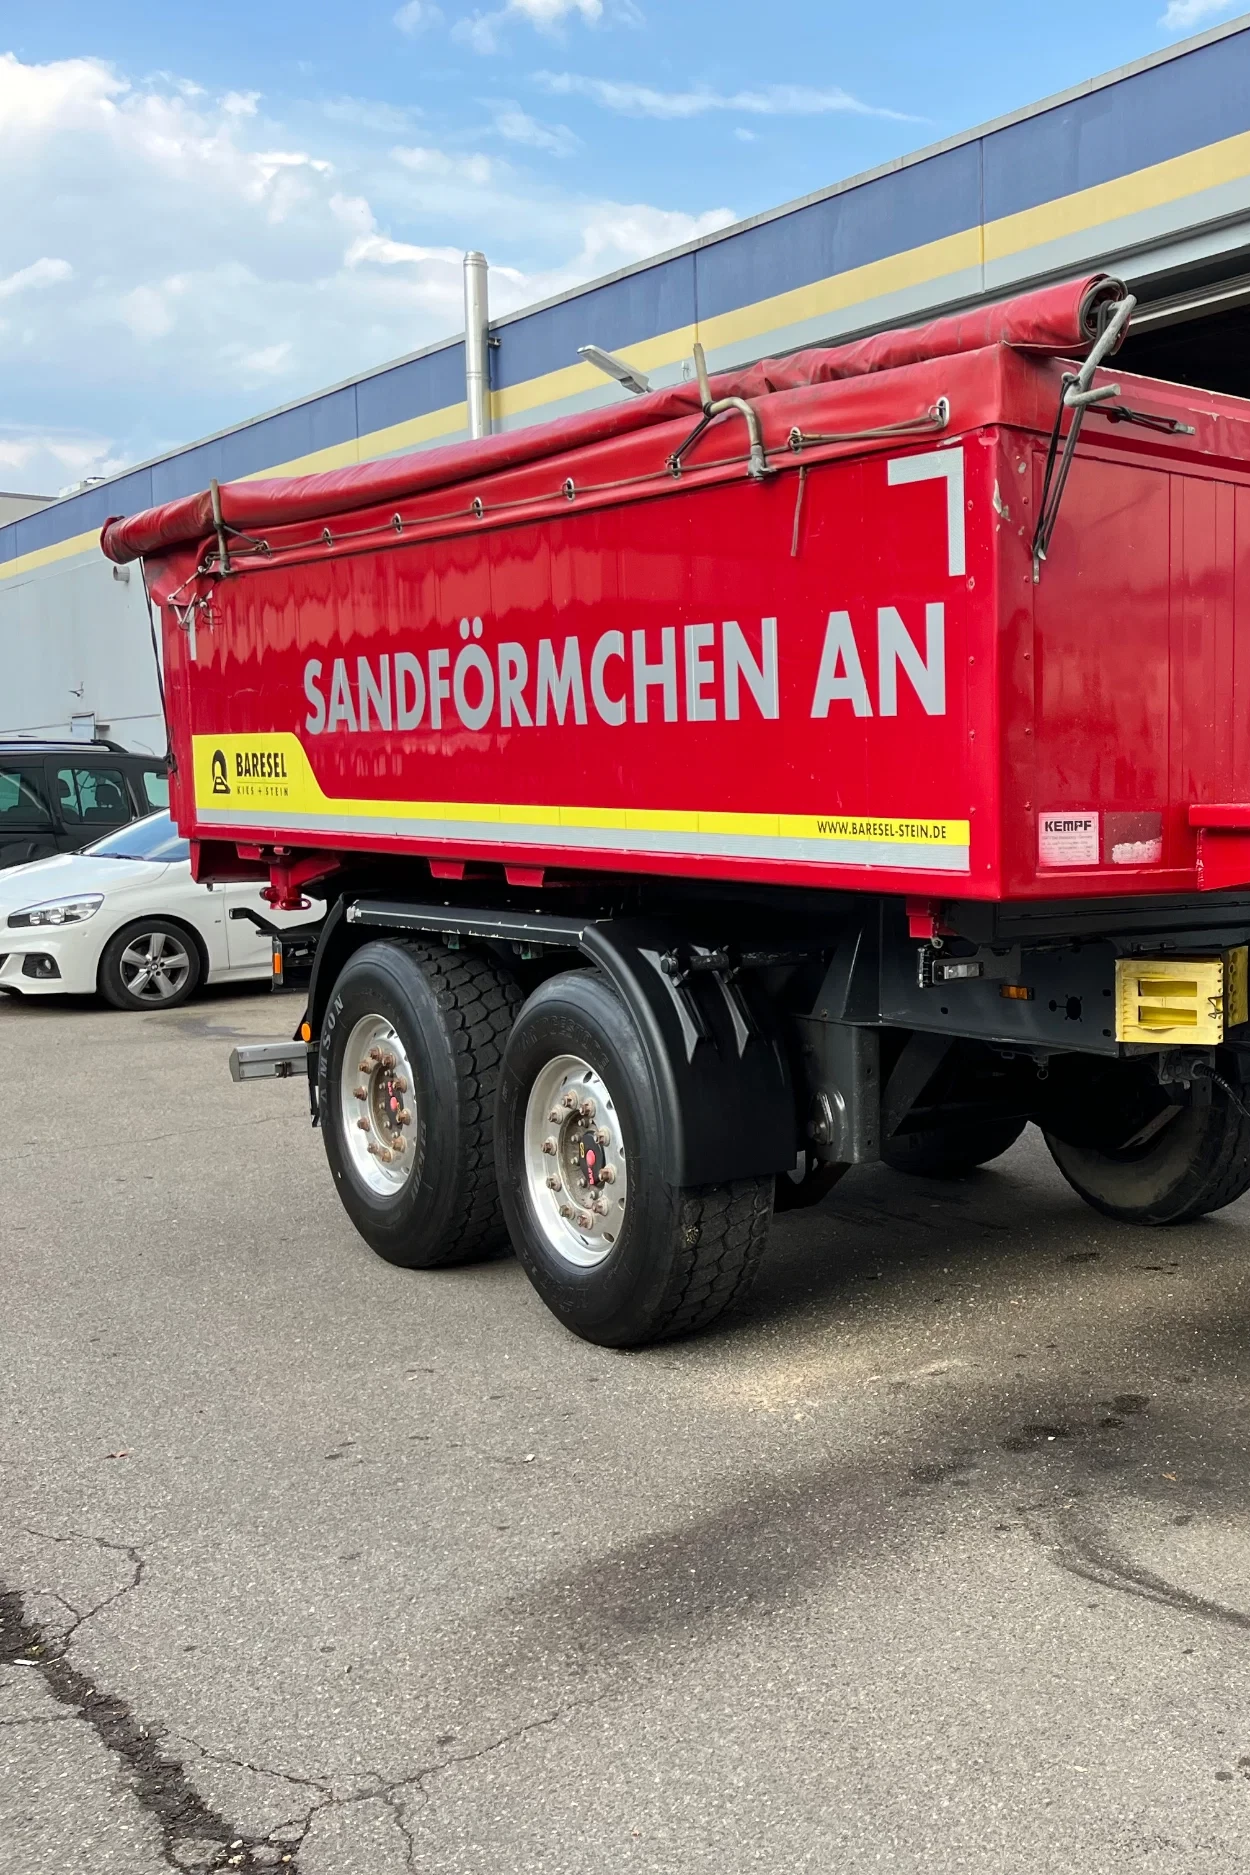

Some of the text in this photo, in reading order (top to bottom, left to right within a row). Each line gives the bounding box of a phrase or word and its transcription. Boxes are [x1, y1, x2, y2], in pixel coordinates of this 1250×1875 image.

[303, 602, 946, 735] SANDFÖRMCHEN AN
[235, 752, 288, 778] BARESEL
[236, 786, 254, 795] KIES
[265, 787, 289, 796] STEIN
[816, 820, 947, 839] WWW.BARESEL-STEIN.DE
[1044, 820, 1092, 832] KEMPF
